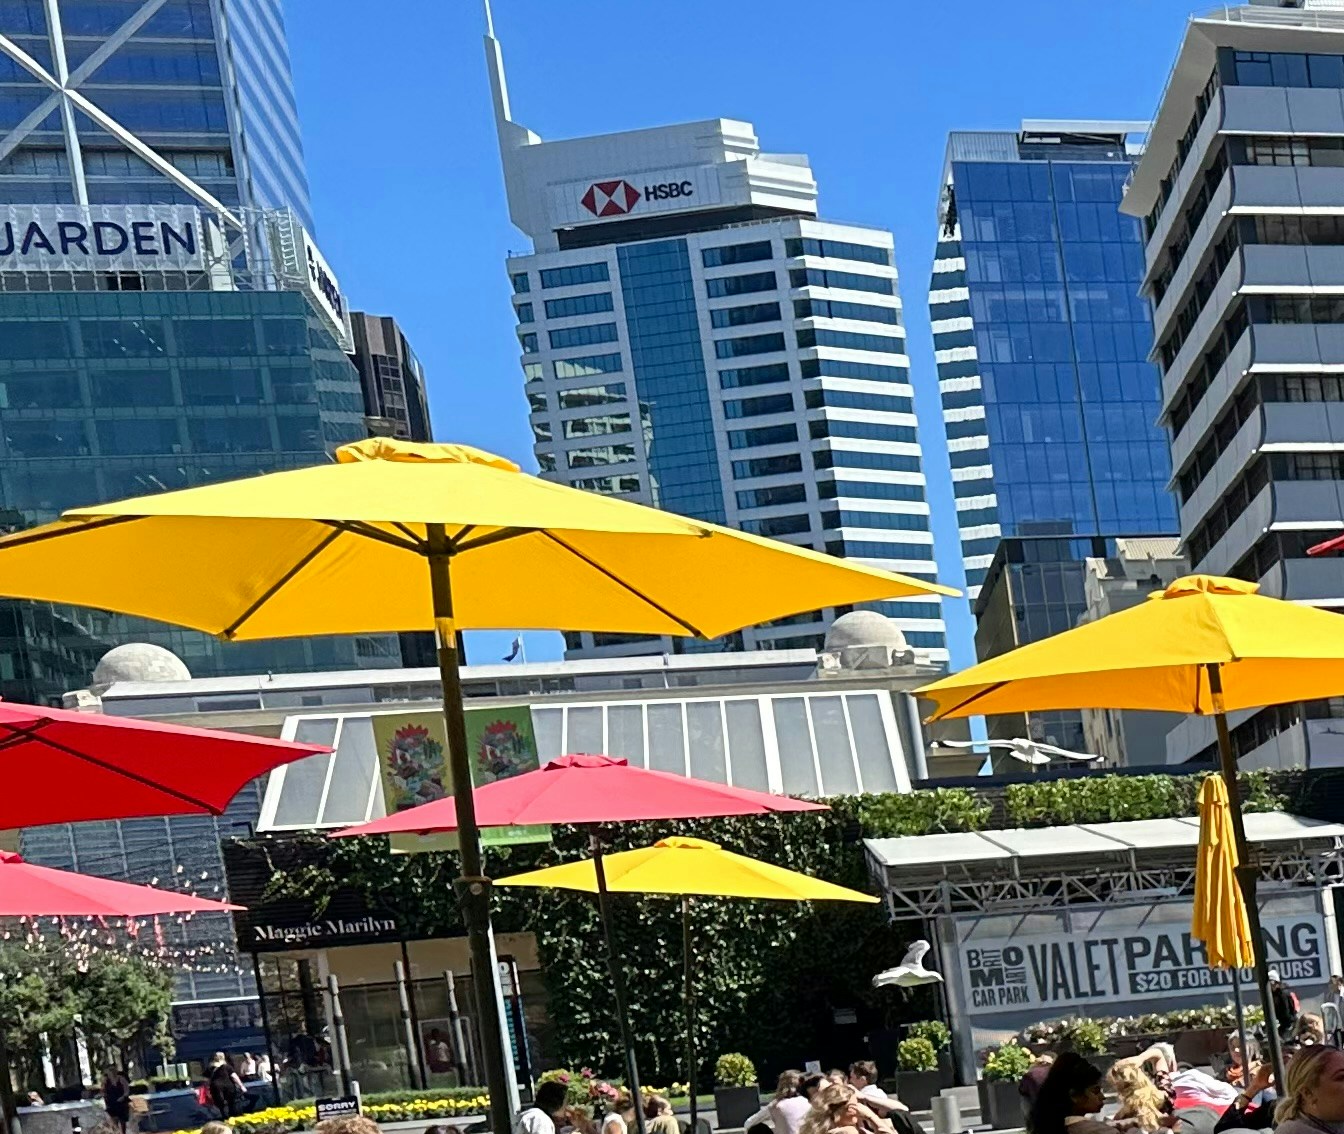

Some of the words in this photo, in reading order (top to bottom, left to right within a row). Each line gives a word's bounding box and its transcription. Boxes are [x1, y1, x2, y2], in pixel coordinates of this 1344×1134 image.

[644, 181, 693, 201] HSBC
[0, 221, 196, 256] JARDEN
[254, 922, 321, 945] Maggie
[326, 917, 396, 936] Marilyn
[1027, 938, 1119, 1001] VALET
[1124, 922, 1319, 971] PARNG
[1135, 972, 1172, 992] $20
[1177, 968, 1212, 987] FOR
[1267, 960, 1315, 979] OURS
[972, 987, 996, 1007] CAR
[999, 985, 1030, 1006] PARK
